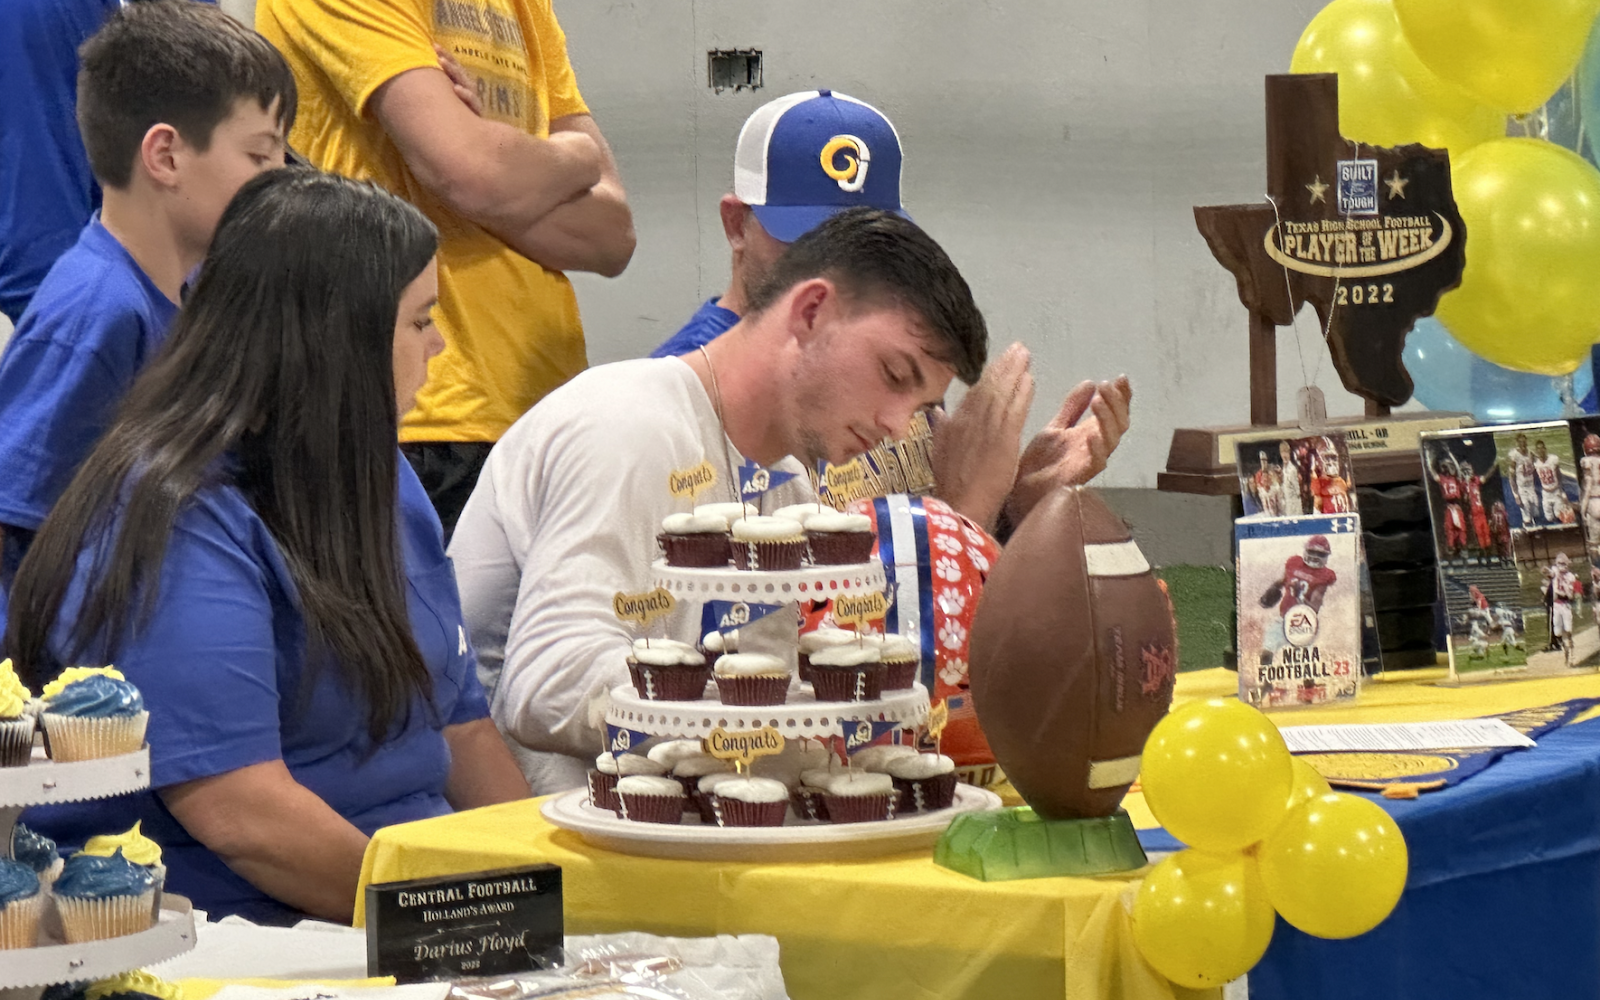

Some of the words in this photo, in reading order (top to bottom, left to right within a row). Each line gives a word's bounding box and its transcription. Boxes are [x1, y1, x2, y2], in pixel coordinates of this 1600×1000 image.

[1342, 166, 1373, 181] BUILT
[1342, 197, 1374, 209] TOUGH
[1284, 221, 1319, 234] TEXAS
[1346, 218, 1382, 231] SCHOOL
[1384, 215, 1432, 229] FOOTBALL
[1284, 231, 1358, 263] PLAYER
[1361, 231, 1374, 247] OF
[1377, 227, 1433, 260] WEEK
[1359, 246, 1376, 262] THE
[1337, 284, 1394, 305] 2022
[670, 467, 712, 494] Congrats
[615, 592, 670, 619] Congrats
[836, 594, 883, 620] Congrats
[1290, 613, 1312, 627] EA
[1283, 646, 1320, 664] NCAA
[1258, 662, 1331, 682] FOOTBALL
[1333, 661, 1350, 675] 23
[712, 731, 779, 757] Congrats
[398, 888, 464, 908] CENTRAL
[468, 878, 538, 899] FOOTBALL
[480, 901, 515, 915] AWARD
[414, 940, 473, 961] Darius
[476, 929, 530, 956] Floyd
